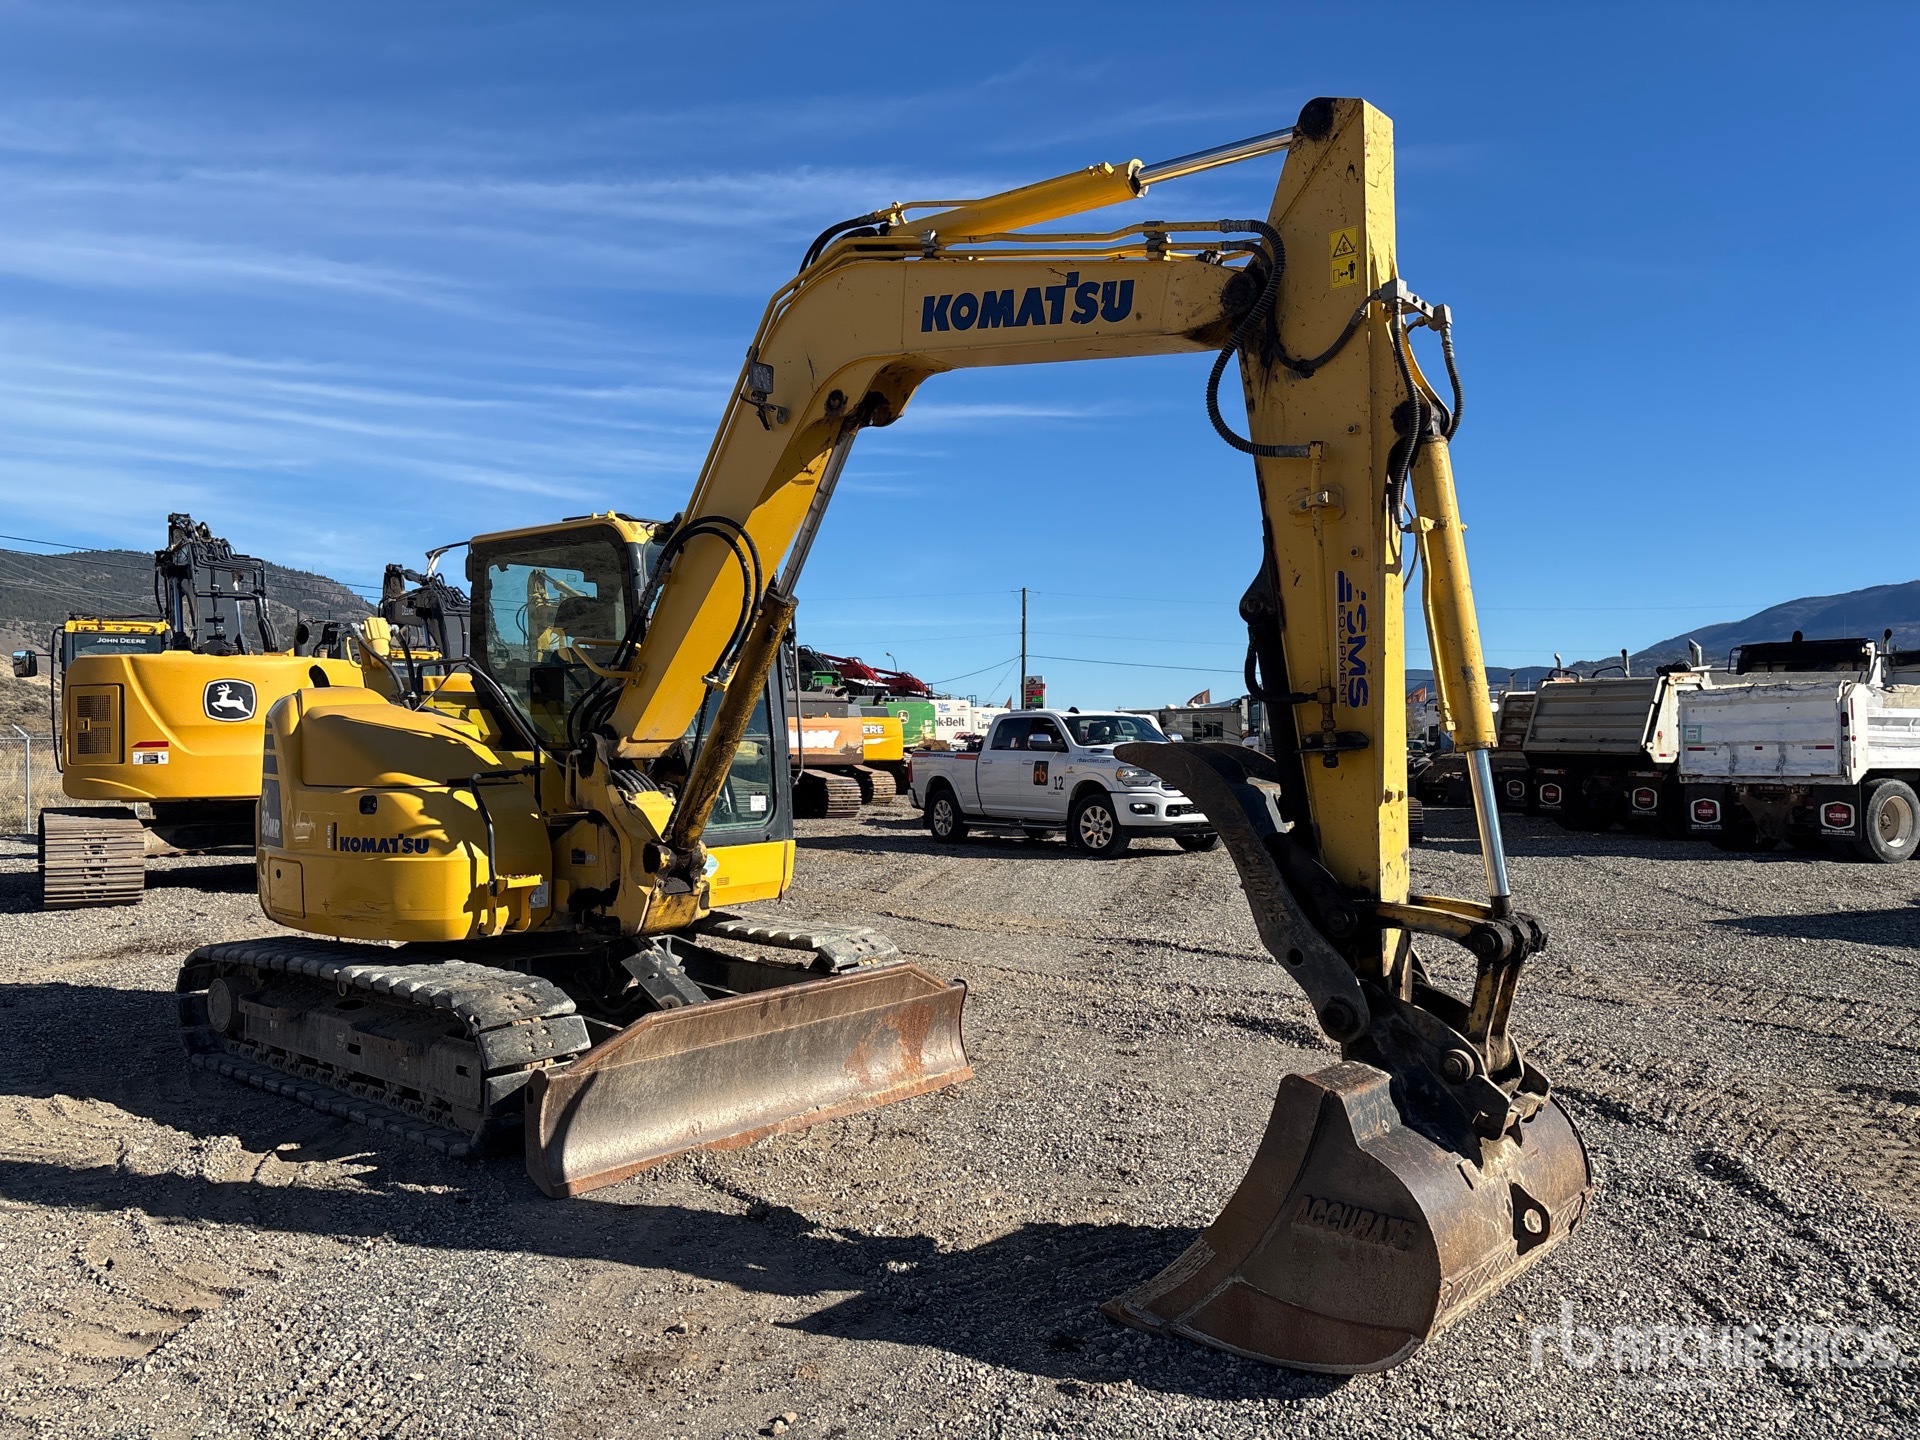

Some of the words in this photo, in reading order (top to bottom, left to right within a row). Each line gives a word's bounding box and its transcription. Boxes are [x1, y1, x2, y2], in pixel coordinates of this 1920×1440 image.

[921, 271, 1135, 333] KOMATSU
[1338, 604, 1347, 708] EQUIPMENT
[1346, 603, 1369, 709] SMS
[1034, 763, 1047, 784] rb
[1076, 757, 1111, 765] rbauction.com
[1053, 775, 1064, 791] 12
[339, 833, 430, 854] KOMATSU
[1290, 1194, 1418, 1251] ACCURATE
